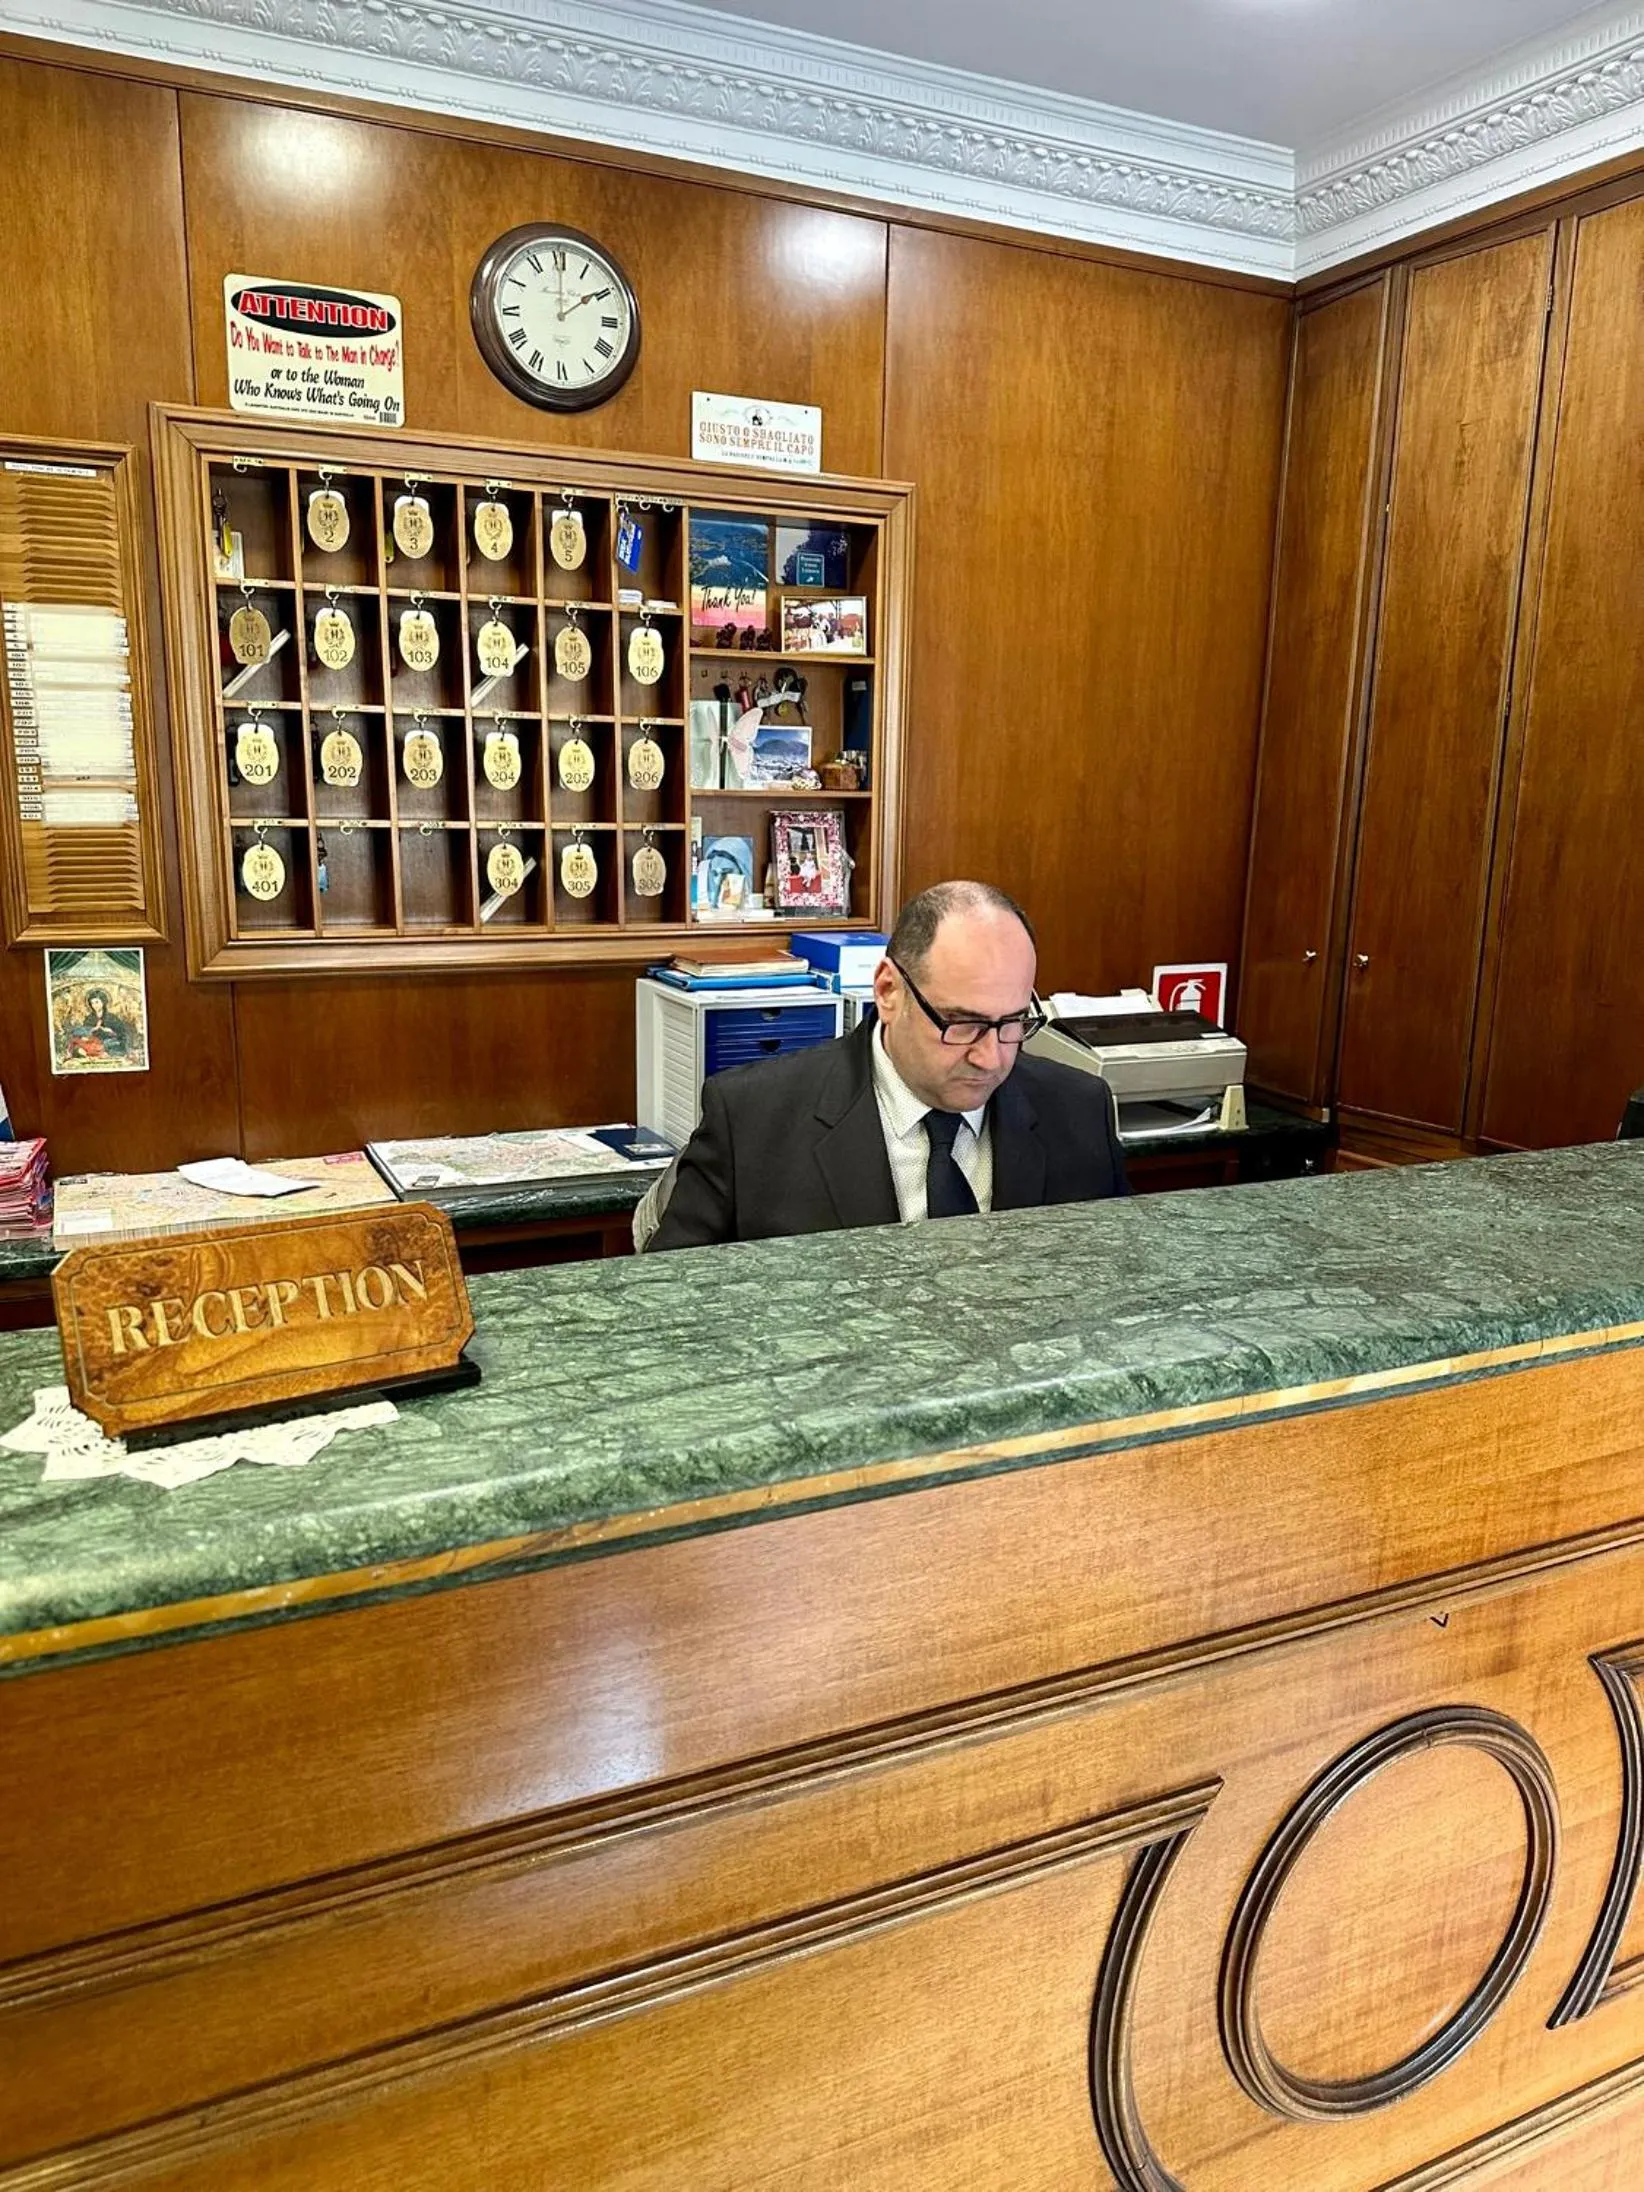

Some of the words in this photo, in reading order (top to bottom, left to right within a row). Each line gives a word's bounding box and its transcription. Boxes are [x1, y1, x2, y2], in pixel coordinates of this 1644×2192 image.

[238, 291, 388, 331] ATTENTION
[601, 316, 618, 329] III
[230, 320, 243, 348] Do
[245, 323, 260, 352] You
[262, 331, 283, 356] Want
[286, 340, 295, 357] to
[297, 341, 312, 360] Talk
[315, 345, 323, 361] to
[326, 343, 339, 362] The
[342, 346, 358, 365] Man
[360, 348, 368, 365] in
[271, 368, 281, 379] or
[286, 367, 297, 381] to
[301, 366, 319, 384] the
[324, 371, 365, 389] Woman
[234, 378, 261, 396] Who
[264, 383, 302, 401] Knows
[306, 387, 344, 406] What's
[348, 391, 380, 413] Going
[384, 396, 400, 412] On
[699, 421, 740, 436] GIUSTO
[743, 427, 750, 436] O
[752, 428, 814, 445] SBAGLIATO
[699, 433, 727, 446] SONO
[730, 436, 771, 451] SEMPRE
[774, 442, 785, 453] IL
[787, 443, 814, 456] CAPO
[323, 530, 334, 543] 2
[410, 537, 418, 550] 3
[490, 542, 498, 553] 4
[564, 550, 572, 562] 5
[701, 586, 731, 612] Thank
[734, 583, 756, 612] You!
[239, 644, 264, 657] 101
[324, 649, 348, 662] 102
[407, 650, 432, 663] 103
[486, 656, 509, 669] 104
[563, 661, 586, 675] 105
[635, 665, 658, 678] 106
[244, 764, 272, 777] 201
[328, 765, 356, 778] 202
[410, 768, 438, 781] 203
[491, 771, 515, 783] 204
[634, 771, 659, 783] 206
[566, 772, 590, 784] 205
[252, 880, 279, 892] 401
[494, 877, 518, 890] 304
[568, 880, 591, 892] 305
[106, 1258, 429, 1356] RECEPTION
